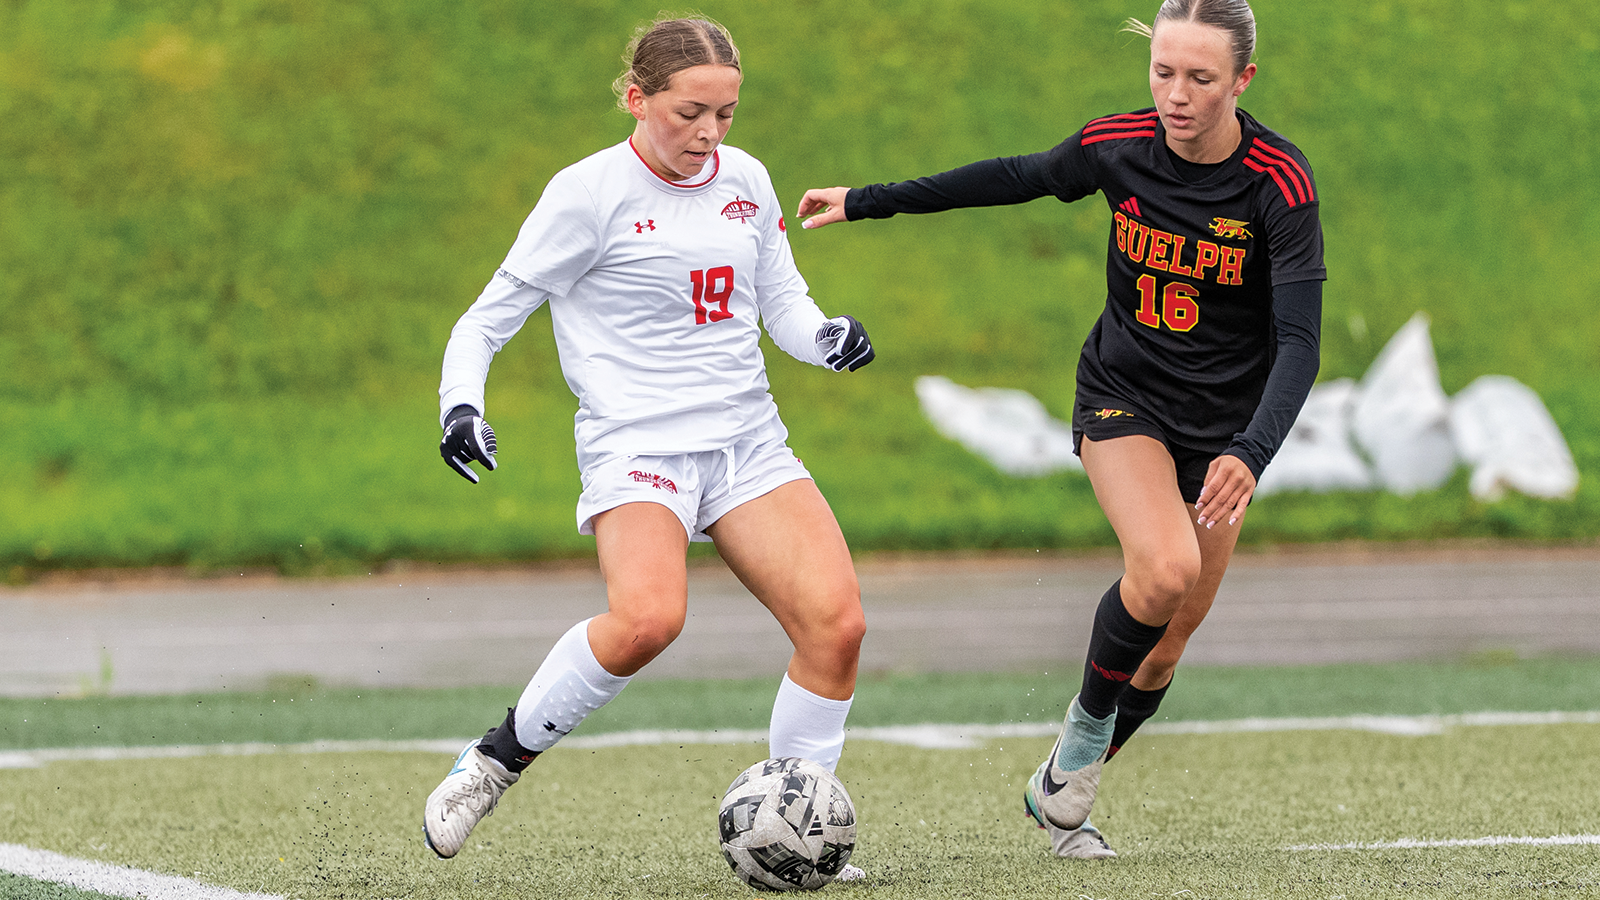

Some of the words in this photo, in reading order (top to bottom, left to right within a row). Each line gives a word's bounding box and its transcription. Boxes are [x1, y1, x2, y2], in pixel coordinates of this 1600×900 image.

[1114, 211, 1246, 286] GUELPH
[690, 265, 735, 325] 19
[1135, 273, 1199, 332] 16
